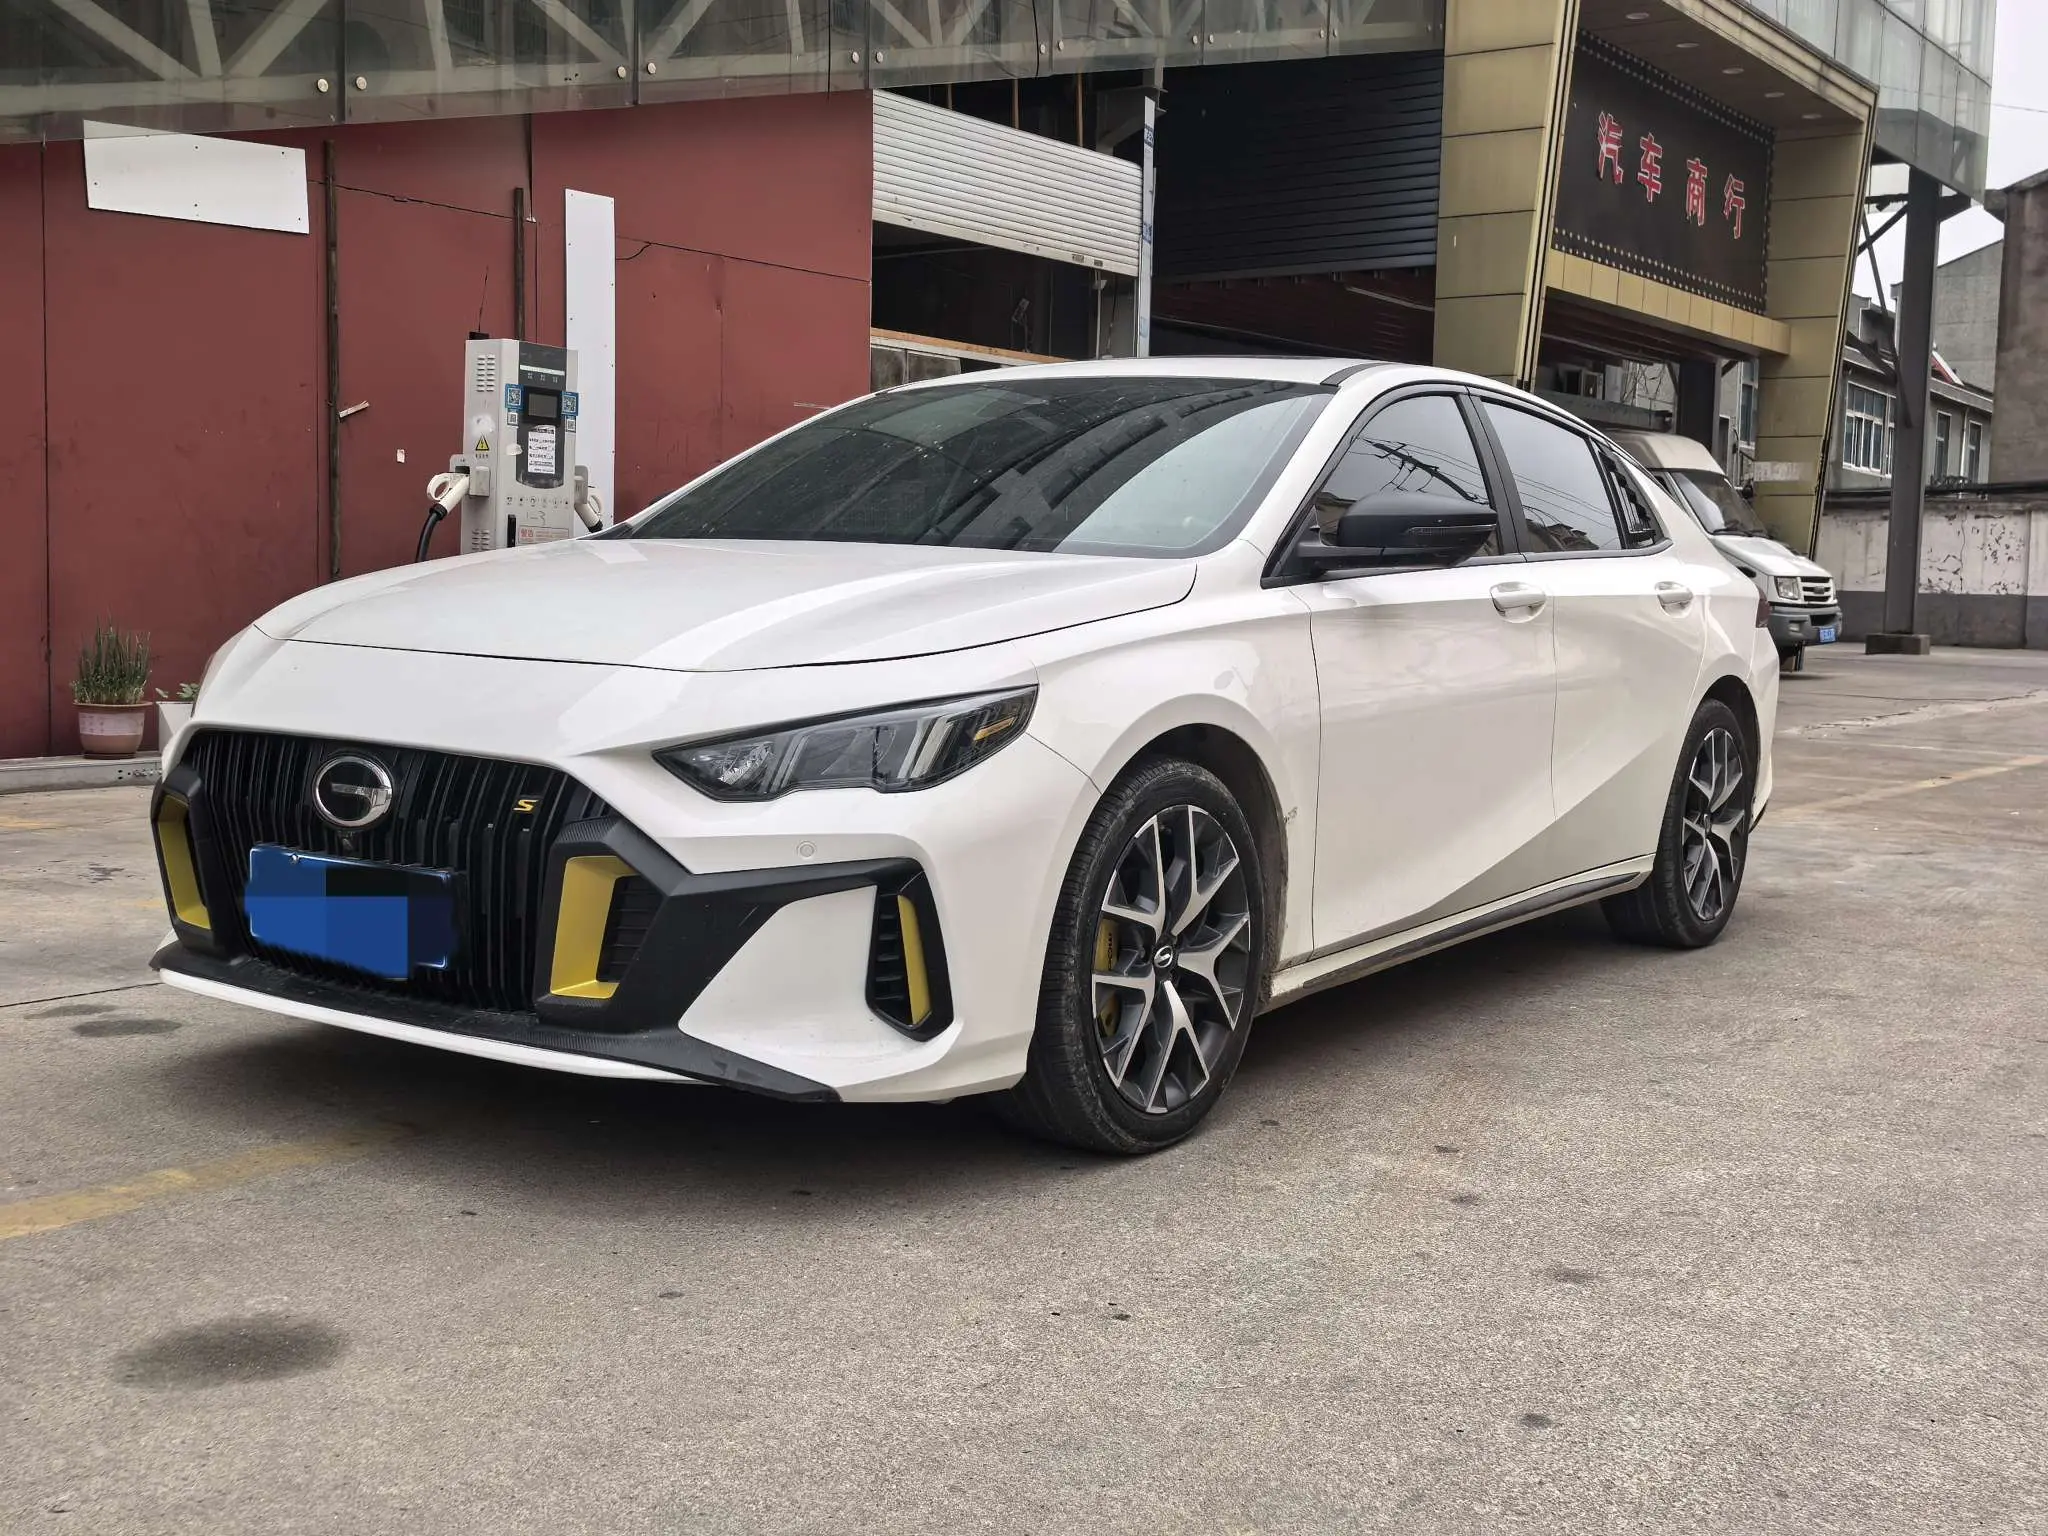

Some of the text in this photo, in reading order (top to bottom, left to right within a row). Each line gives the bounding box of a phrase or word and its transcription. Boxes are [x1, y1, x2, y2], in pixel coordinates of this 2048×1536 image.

[1597, 110, 1746, 240] 汽车商行
[512, 799, 539, 812] S
